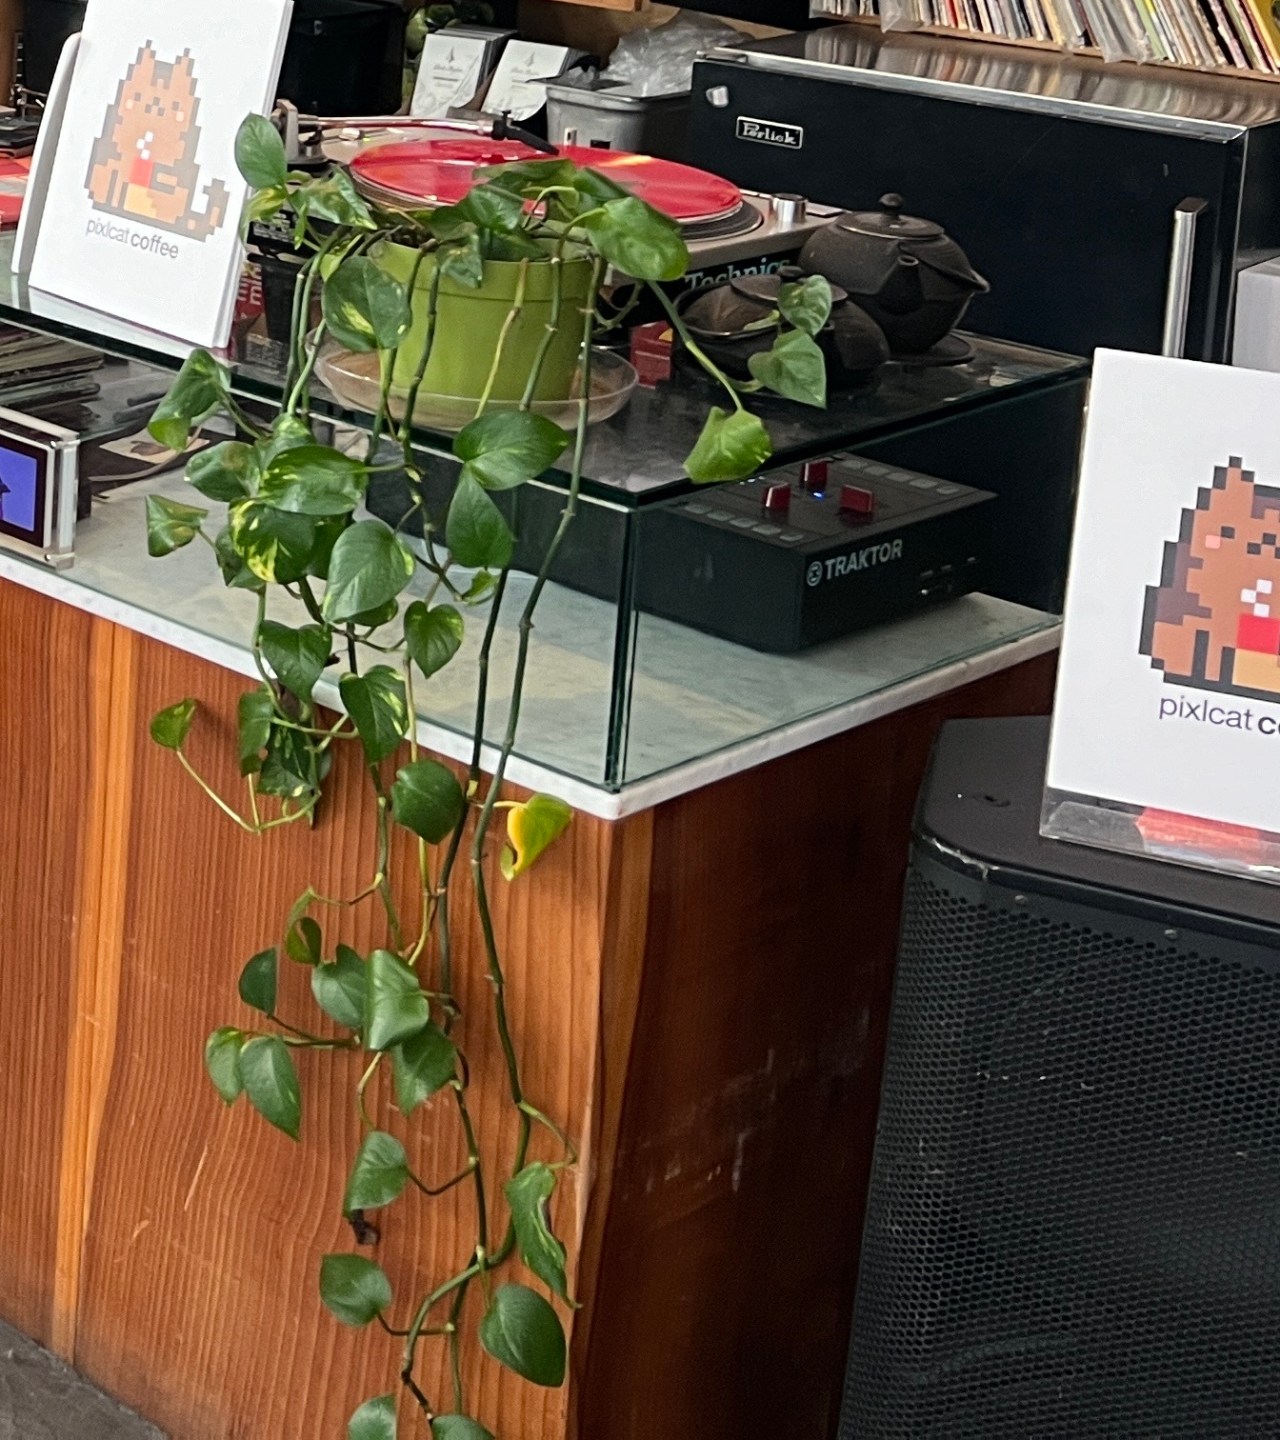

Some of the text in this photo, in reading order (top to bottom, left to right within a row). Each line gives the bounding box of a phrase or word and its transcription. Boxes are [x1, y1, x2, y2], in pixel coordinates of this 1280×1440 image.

[86, 216, 179, 259] pixlcat coffee
[824, 539, 902, 581] TRAKTOR
[1159, 694, 1252, 733] pixlcat
